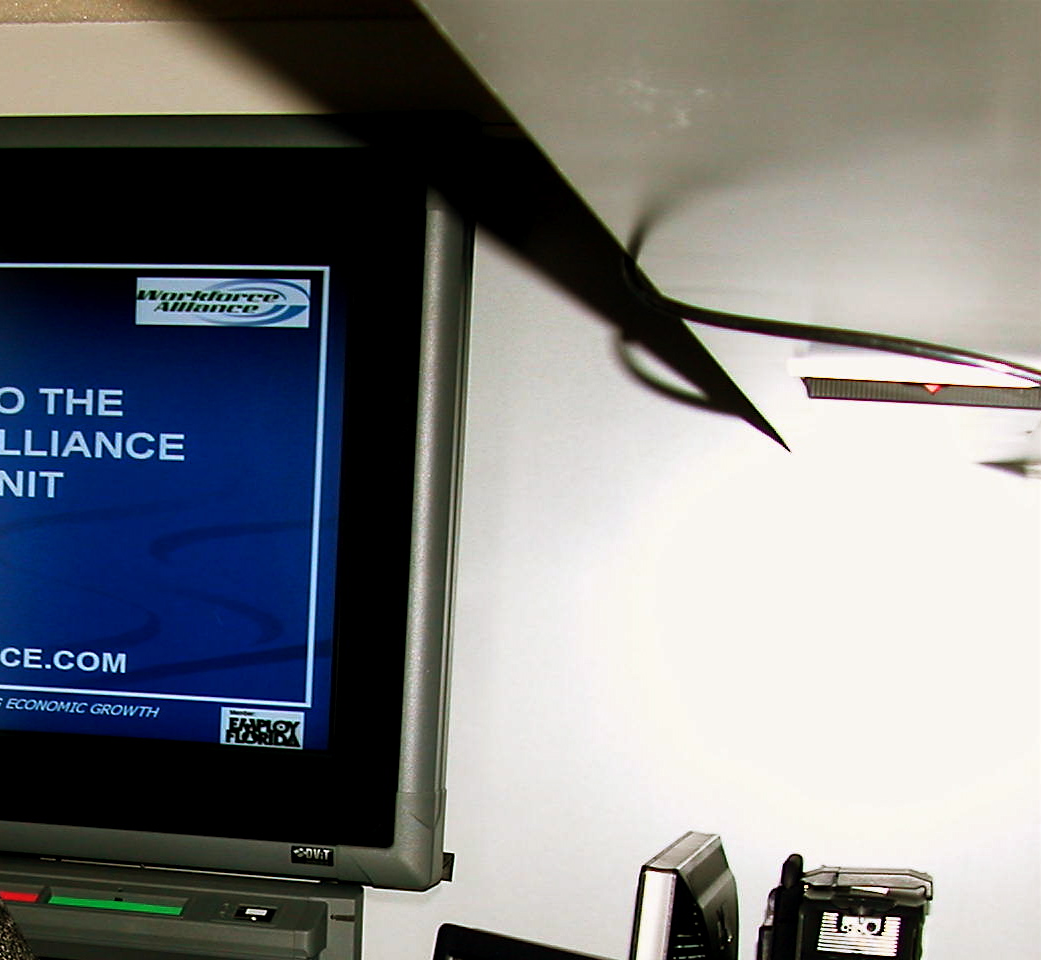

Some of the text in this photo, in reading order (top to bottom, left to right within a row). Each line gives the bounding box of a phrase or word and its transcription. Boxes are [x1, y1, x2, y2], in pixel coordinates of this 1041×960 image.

[136, 289, 280, 302] Workforce
[154, 301, 259, 314] Alliance
[38, 387, 124, 417] THE
[5, 698, 88, 714] ECONOMIC
[89, 702, 161, 719] GROWTH
